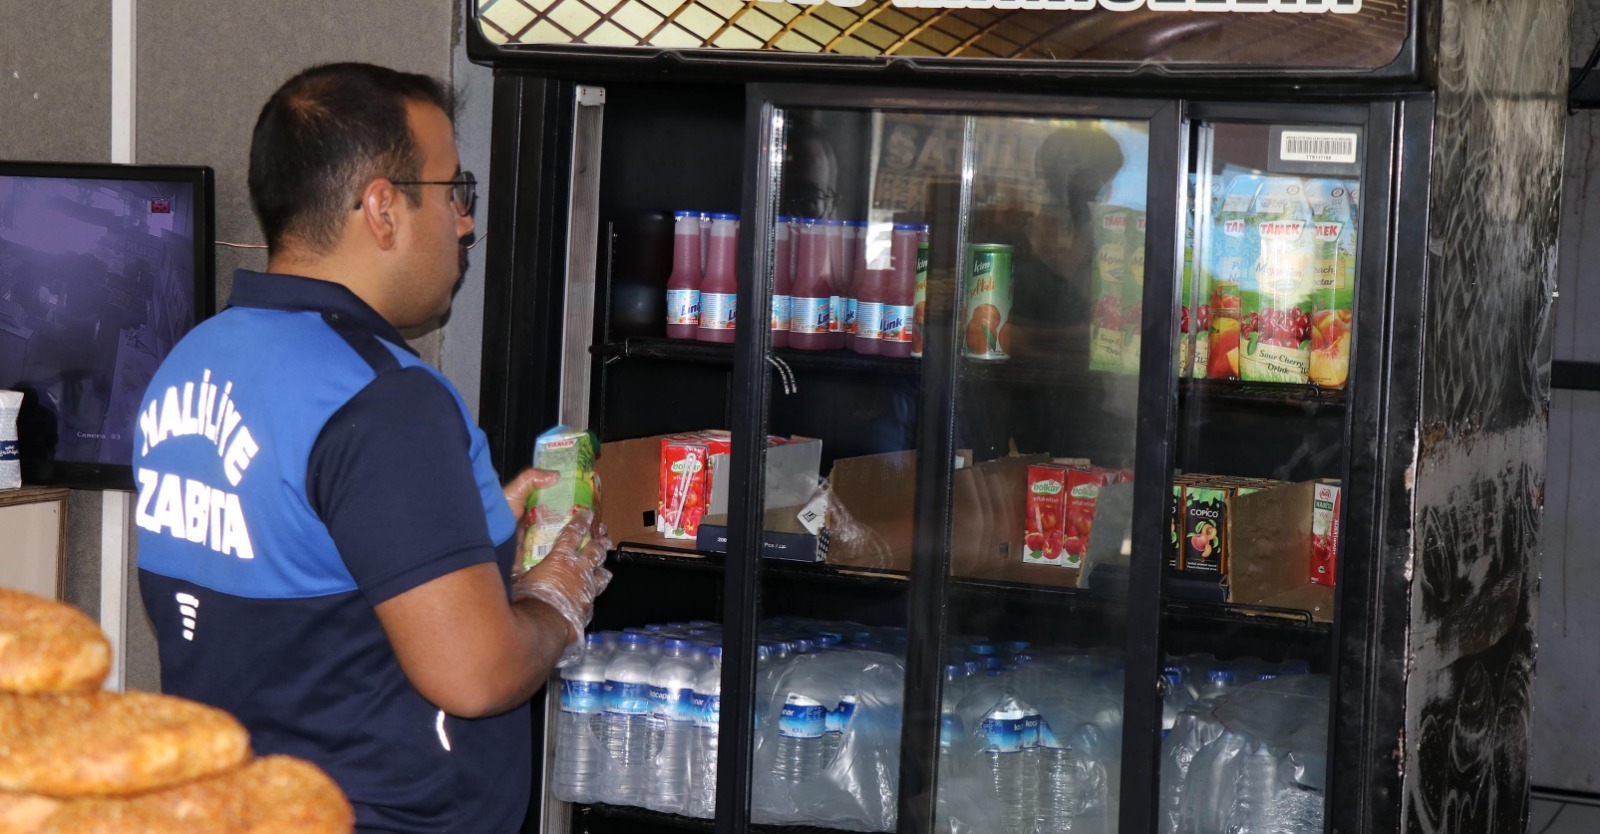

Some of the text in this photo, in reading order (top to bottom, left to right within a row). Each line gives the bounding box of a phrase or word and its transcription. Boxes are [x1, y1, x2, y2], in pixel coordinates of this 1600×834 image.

[1260, 223, 1301, 235] TAMEK
[1314, 225, 1338, 236] MEK
[883, 317, 903, 331] Link
[1259, 350, 1304, 368] Sour Cherry
[1267, 363, 1290, 374] Drink
[77, 431, 121, 440] Camera 03
[136, 467, 254, 559] ZABITA
